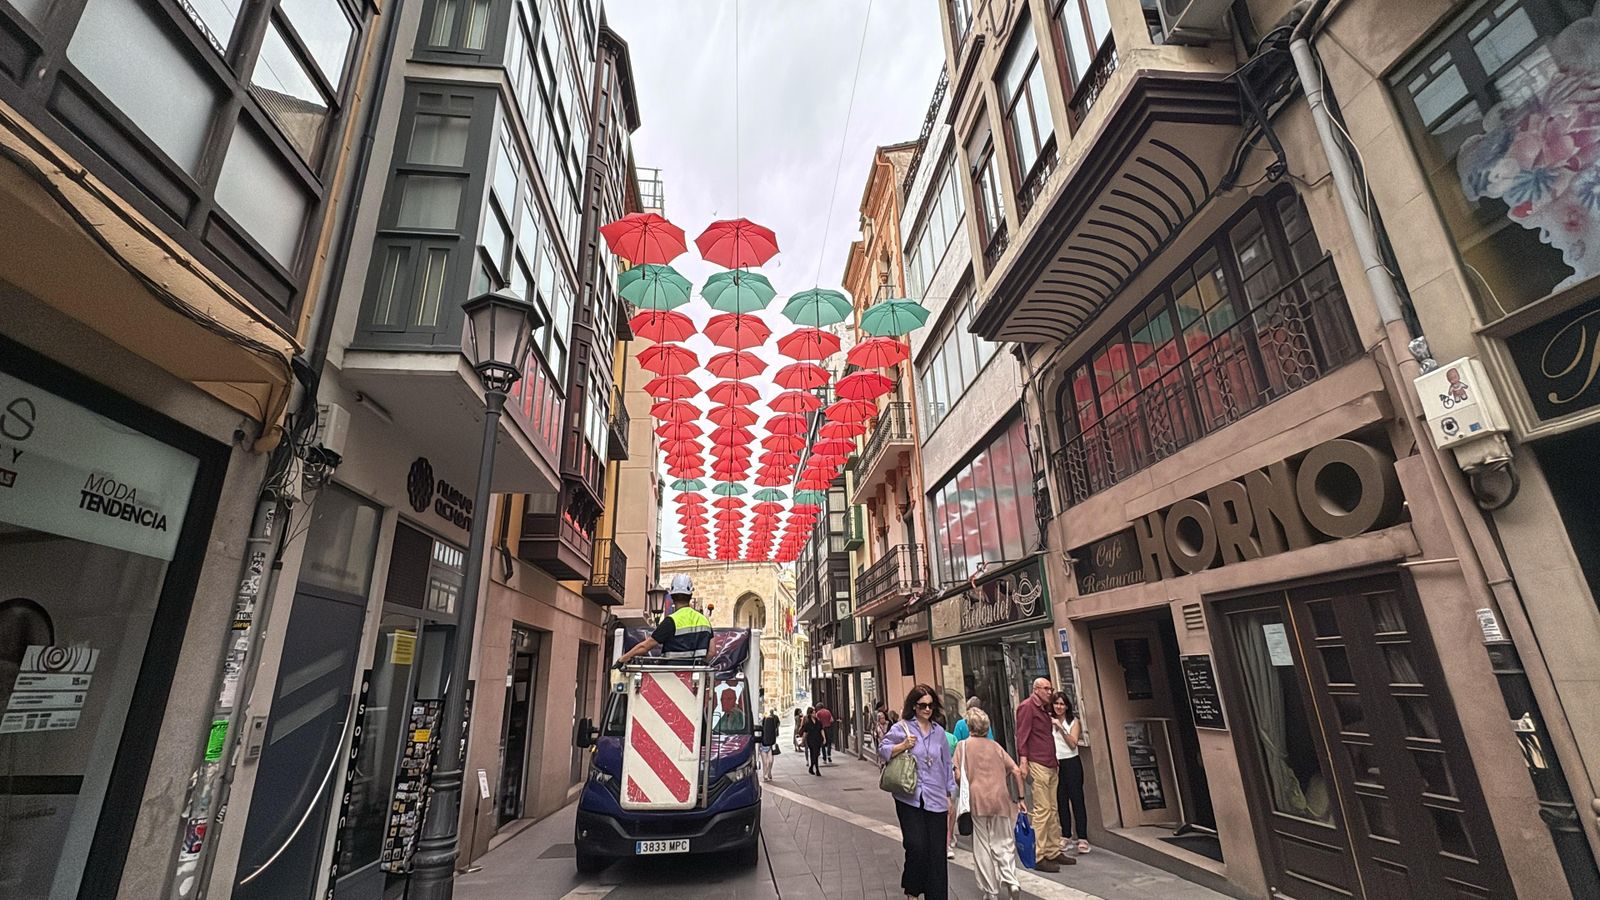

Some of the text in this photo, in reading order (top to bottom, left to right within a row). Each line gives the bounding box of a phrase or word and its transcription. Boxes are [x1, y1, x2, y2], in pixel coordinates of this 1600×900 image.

[84, 473, 137, 504] MODA
[79, 489, 167, 532] TENDENCIA
[1134, 438, 1385, 583] HORNO
[1096, 538, 1122, 568] Café
[642, 840, 688, 853] 3833 MPC
